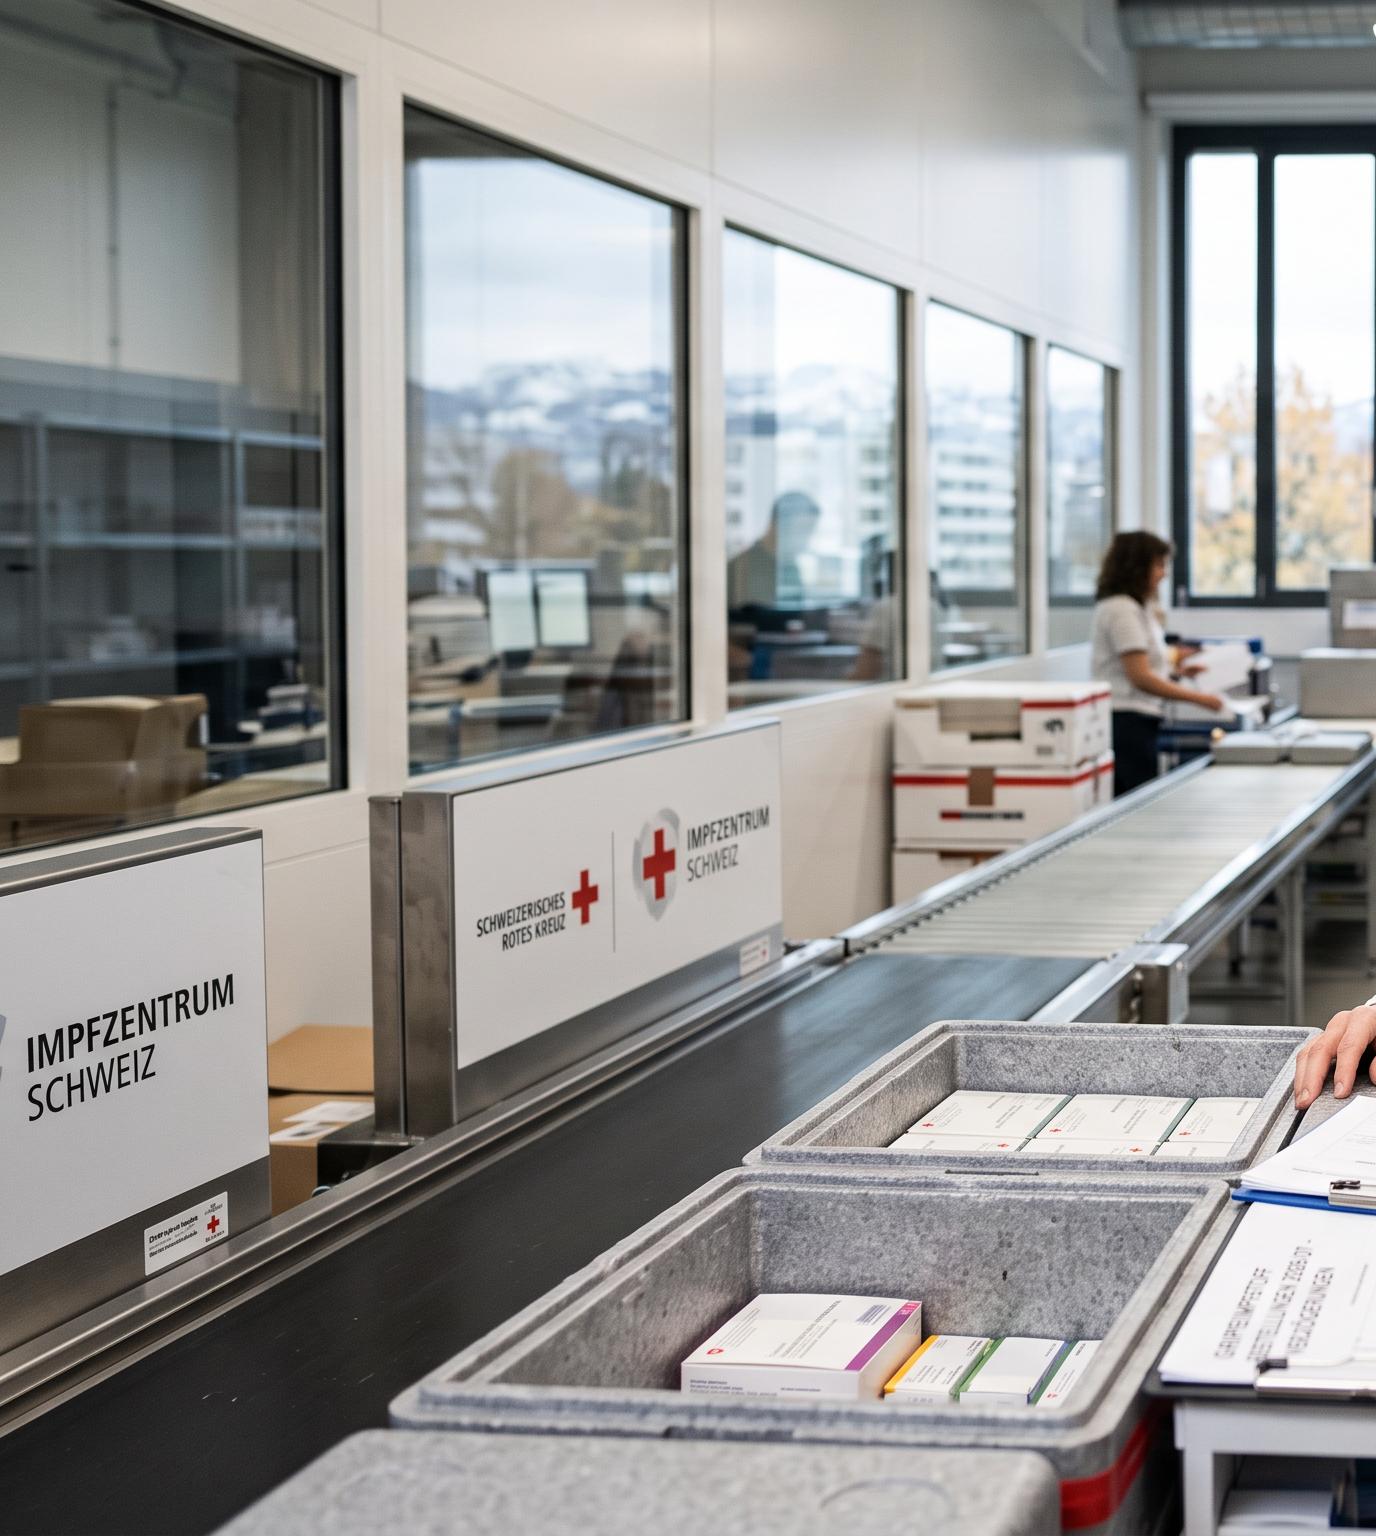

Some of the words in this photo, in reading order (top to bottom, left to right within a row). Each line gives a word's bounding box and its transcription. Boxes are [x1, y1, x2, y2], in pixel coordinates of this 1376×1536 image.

[687, 805, 770, 851] IMPFZENTRUM
[687, 844, 738, 882] SCHWEIZ
[476, 891, 565, 937] SCHWEIZERISCHES
[502, 923, 533, 951] ROTES
[535, 912, 566, 940] KREUZ
[26, 973, 235, 1073] IMPFZENTRUM
[27, 1043, 157, 1123] SCHWEIZ
